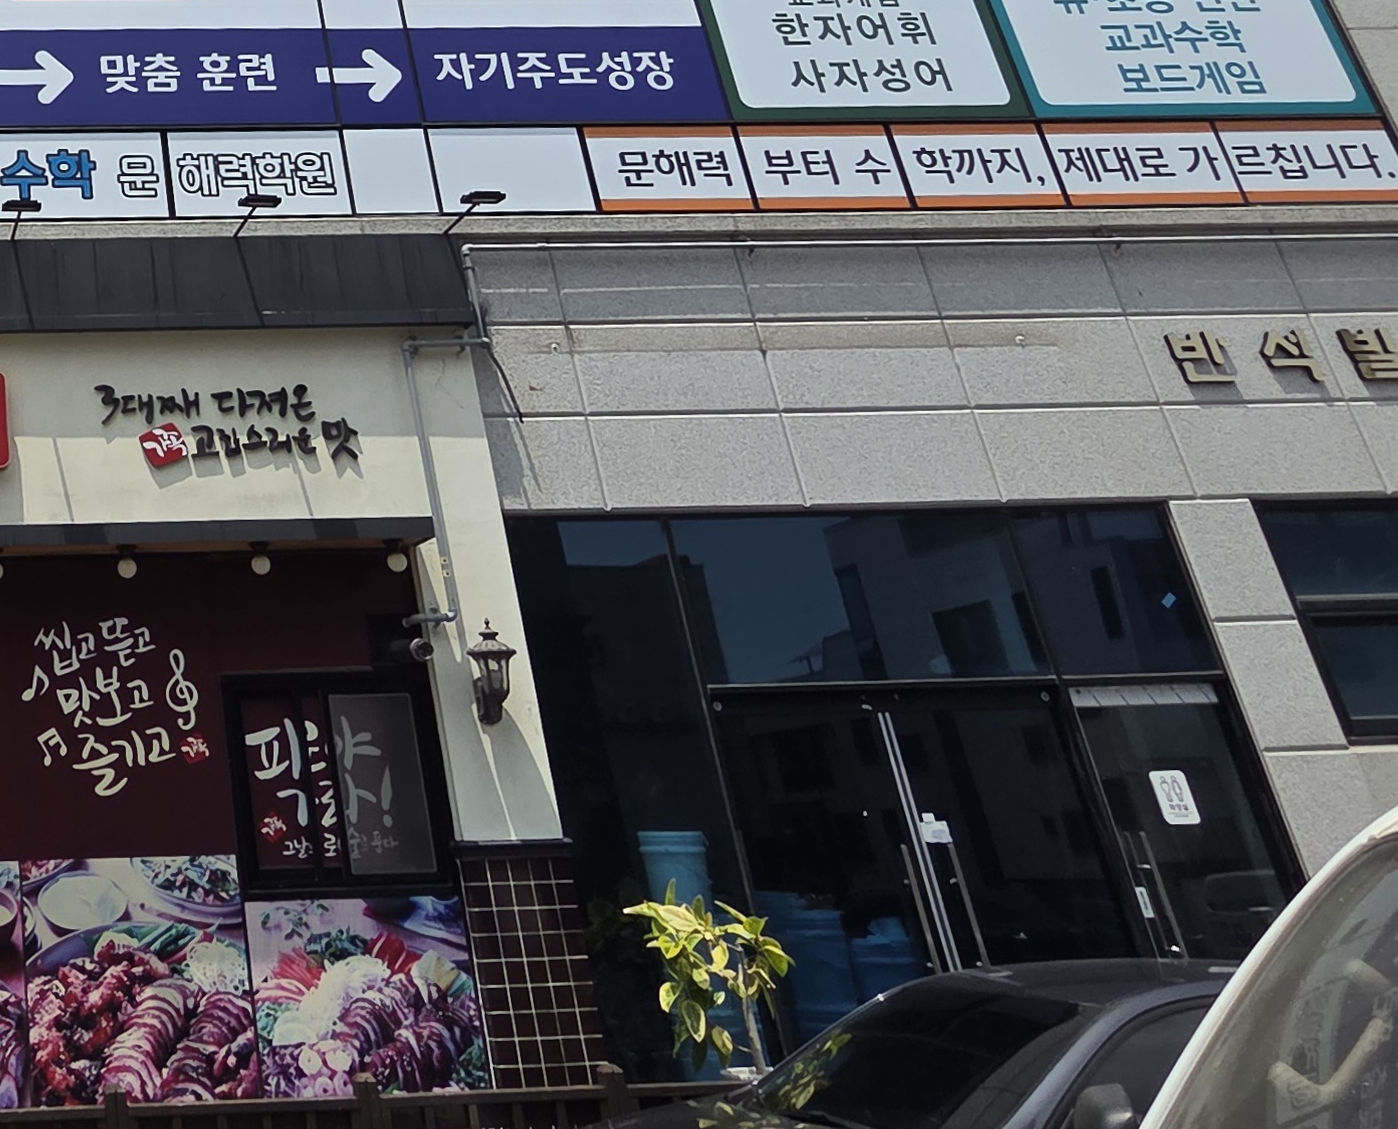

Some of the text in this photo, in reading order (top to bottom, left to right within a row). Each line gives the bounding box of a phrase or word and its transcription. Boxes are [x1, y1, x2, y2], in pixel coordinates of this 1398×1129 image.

[771, 11, 937, 46] 한자어휘
[1100, 20, 1247, 54] 교과수학
[99, 53, 181, 93] 맞춤
[196, 53, 278, 92] 훈련
[433, 51, 675, 91] 자기주도성장
[791, 58, 953, 93] 사자성어
[1117, 60, 1267, 95] 보드게임
[1057, 145, 1177, 184] 제대로
[94, 383, 200, 426] 3대째
[321, 417, 359, 461] 맛
[56, 666, 154, 729] 맛보고
[72, 726, 177, 797] 즐기고
